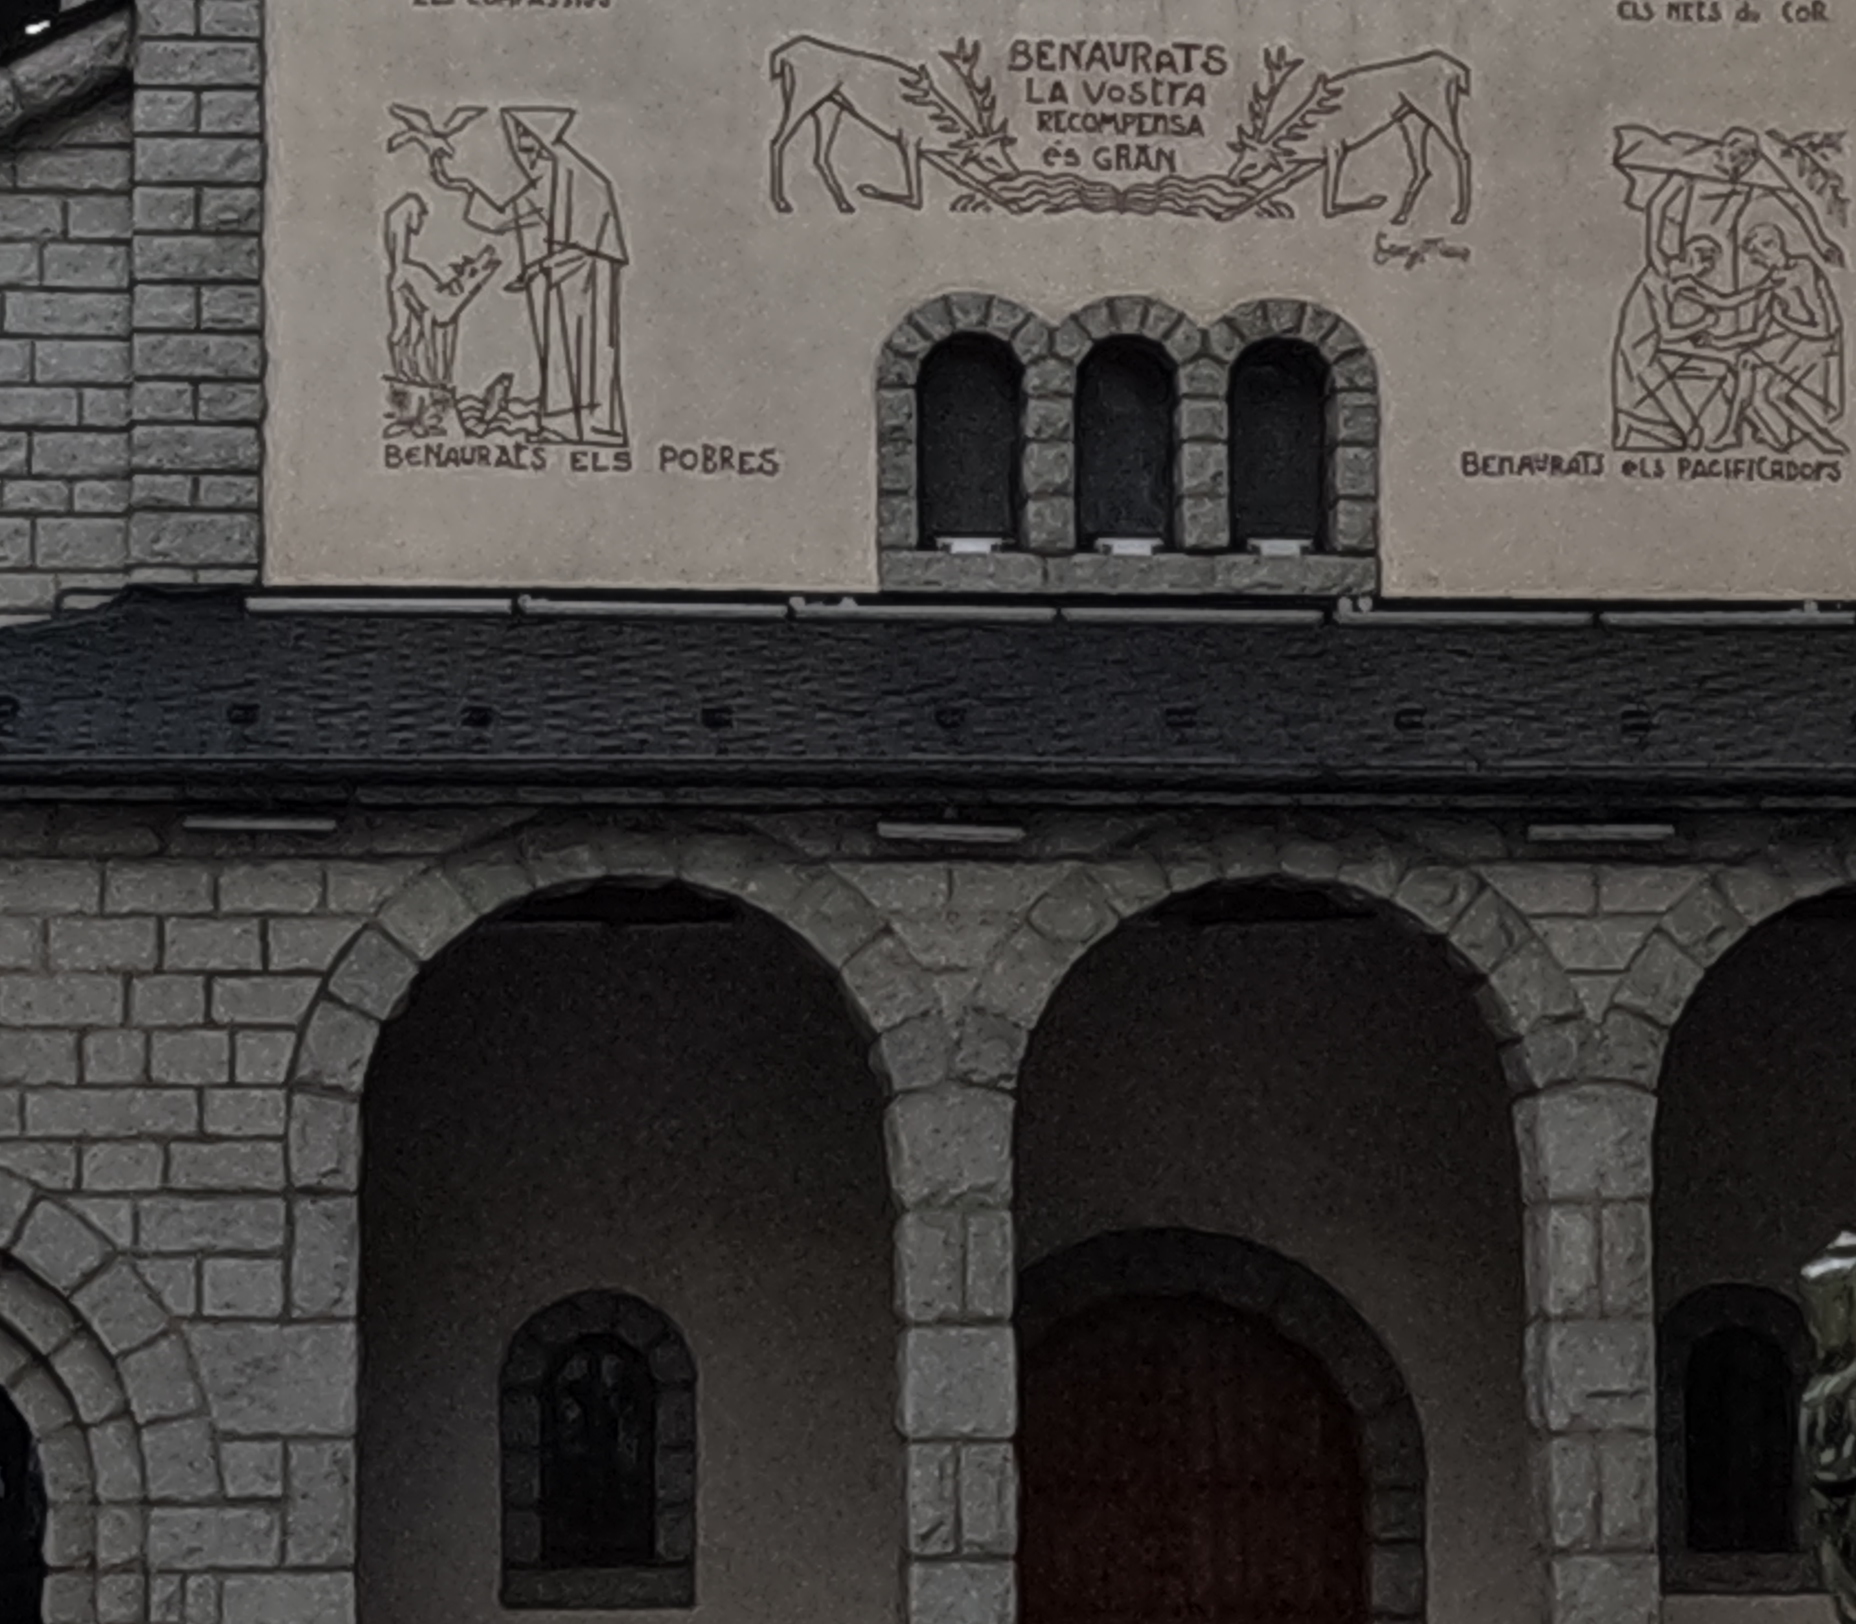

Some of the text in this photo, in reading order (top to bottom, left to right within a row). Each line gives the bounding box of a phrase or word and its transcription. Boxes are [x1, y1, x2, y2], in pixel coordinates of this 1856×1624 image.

[1782, 0, 1829, 23] COR
[1007, 39, 1227, 75] BENAURATS
[1026, 78, 1068, 104] LA
[1037, 110, 1205, 137] RECOMPENSA
[1093, 144, 1176, 172] GRAN
[384, 442, 780, 477] BENAURATS ELS POBRES
